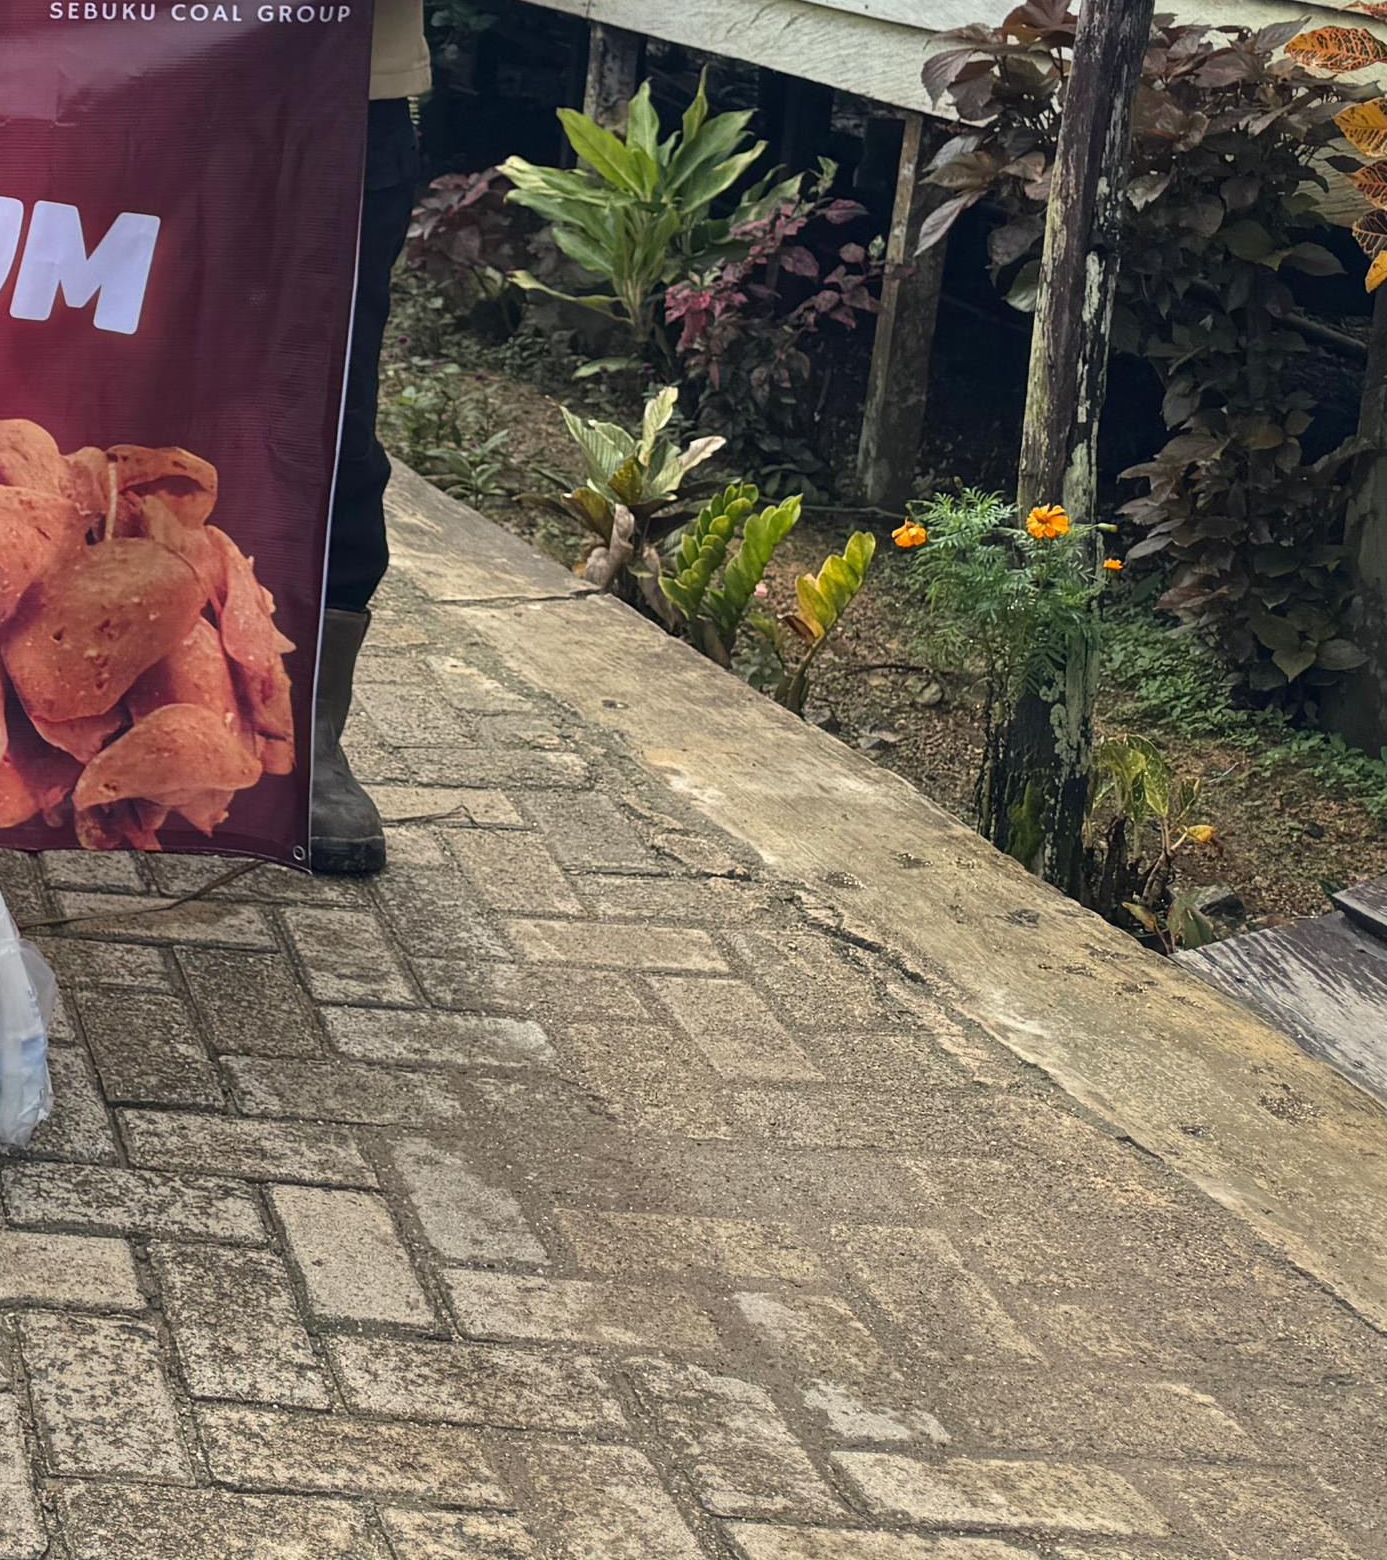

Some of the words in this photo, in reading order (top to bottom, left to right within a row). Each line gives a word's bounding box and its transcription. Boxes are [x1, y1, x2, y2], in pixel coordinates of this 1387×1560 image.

[49, 2, 156, 21] SEBUKU
[171, 3, 242, 22] COAL
[257, 5, 351, 23] GROUP
